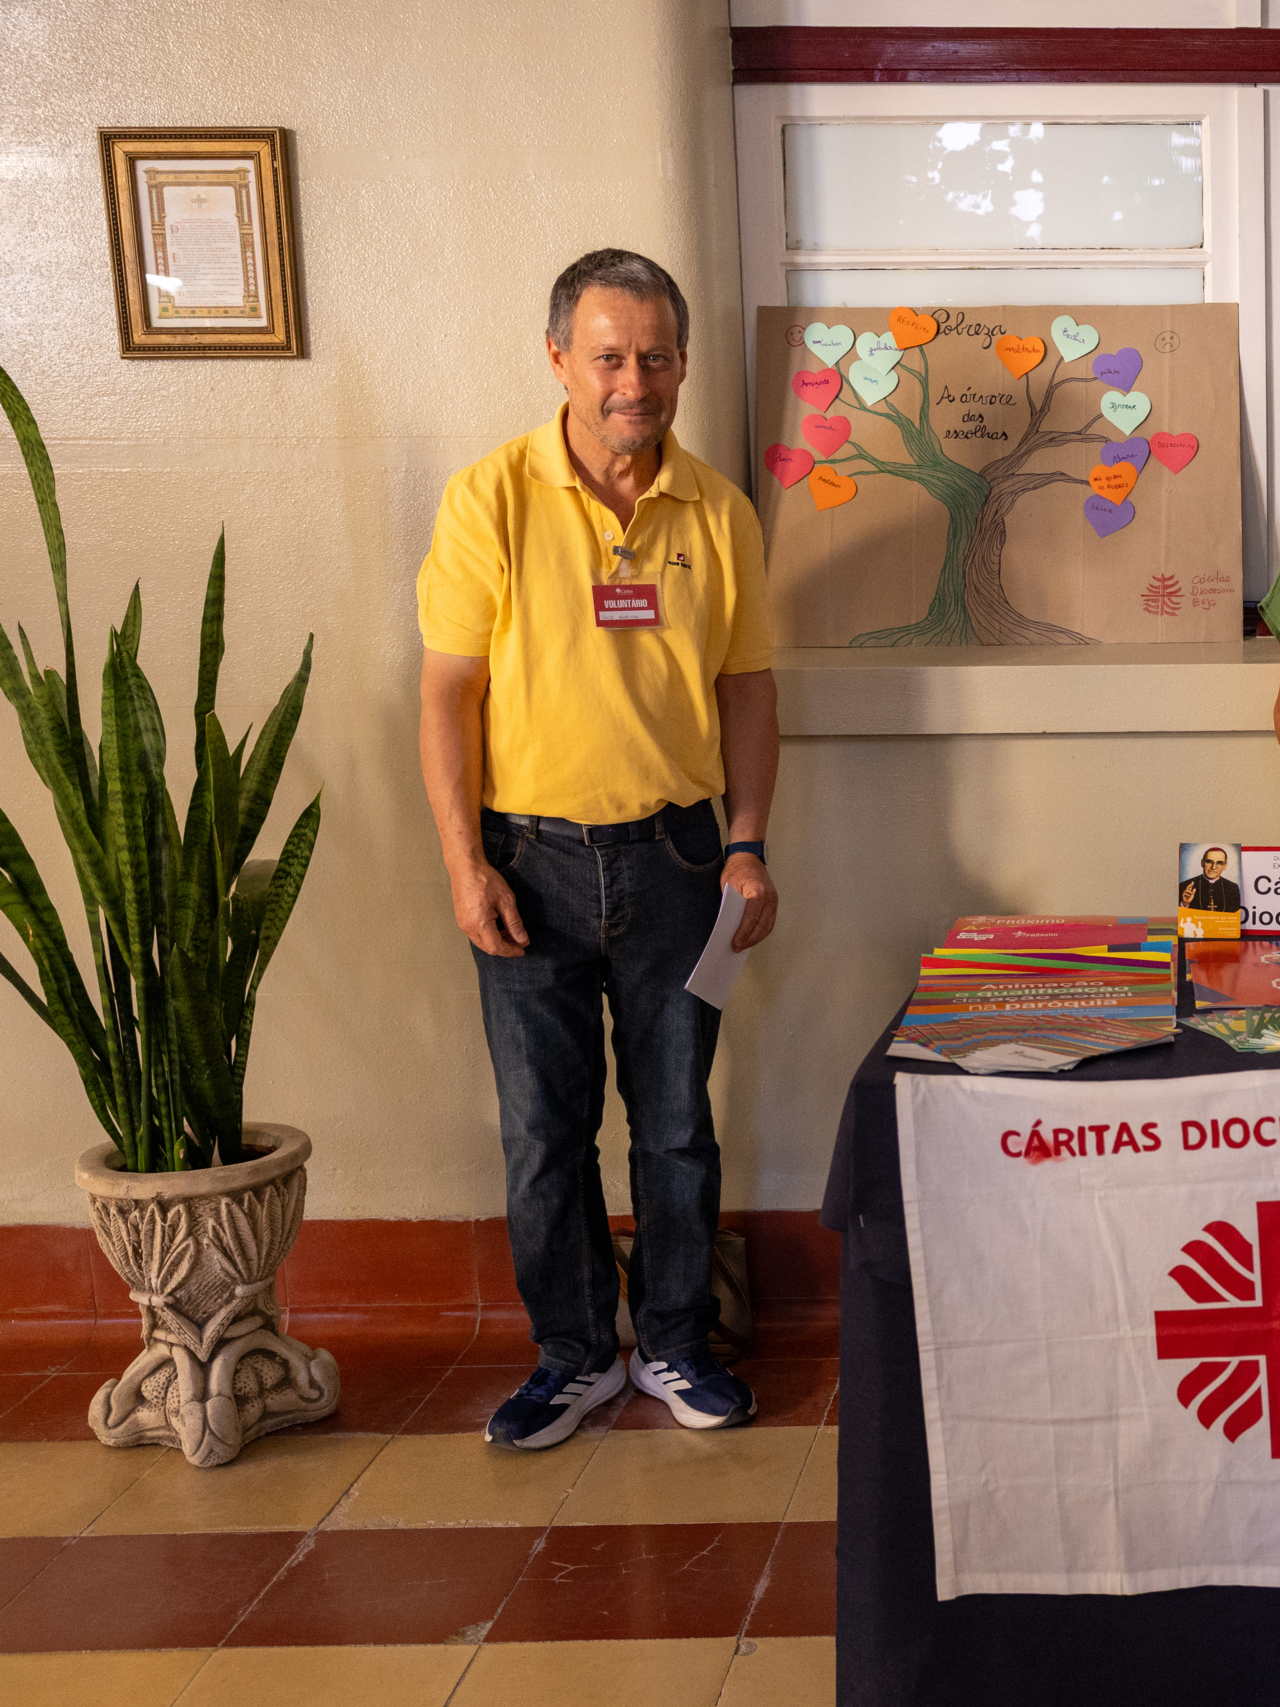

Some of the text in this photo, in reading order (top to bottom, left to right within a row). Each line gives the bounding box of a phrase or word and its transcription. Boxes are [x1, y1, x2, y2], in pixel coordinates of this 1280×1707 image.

[931, 308, 1007, 349] Pobreza
[960, 386, 1017, 406] árvore
[962, 409, 985, 423] das
[943, 424, 1008, 440] escolhas
[603, 598, 648, 609] VOLUNTÁRIO
[976, 985, 1130, 998] qualificação
[980, 980, 1105, 990] Animação
[989, 994, 1051, 1002] ação
[1005, 999, 1118, 1011] paróquia
[1000, 1119, 1162, 1159] CÁRITAS
